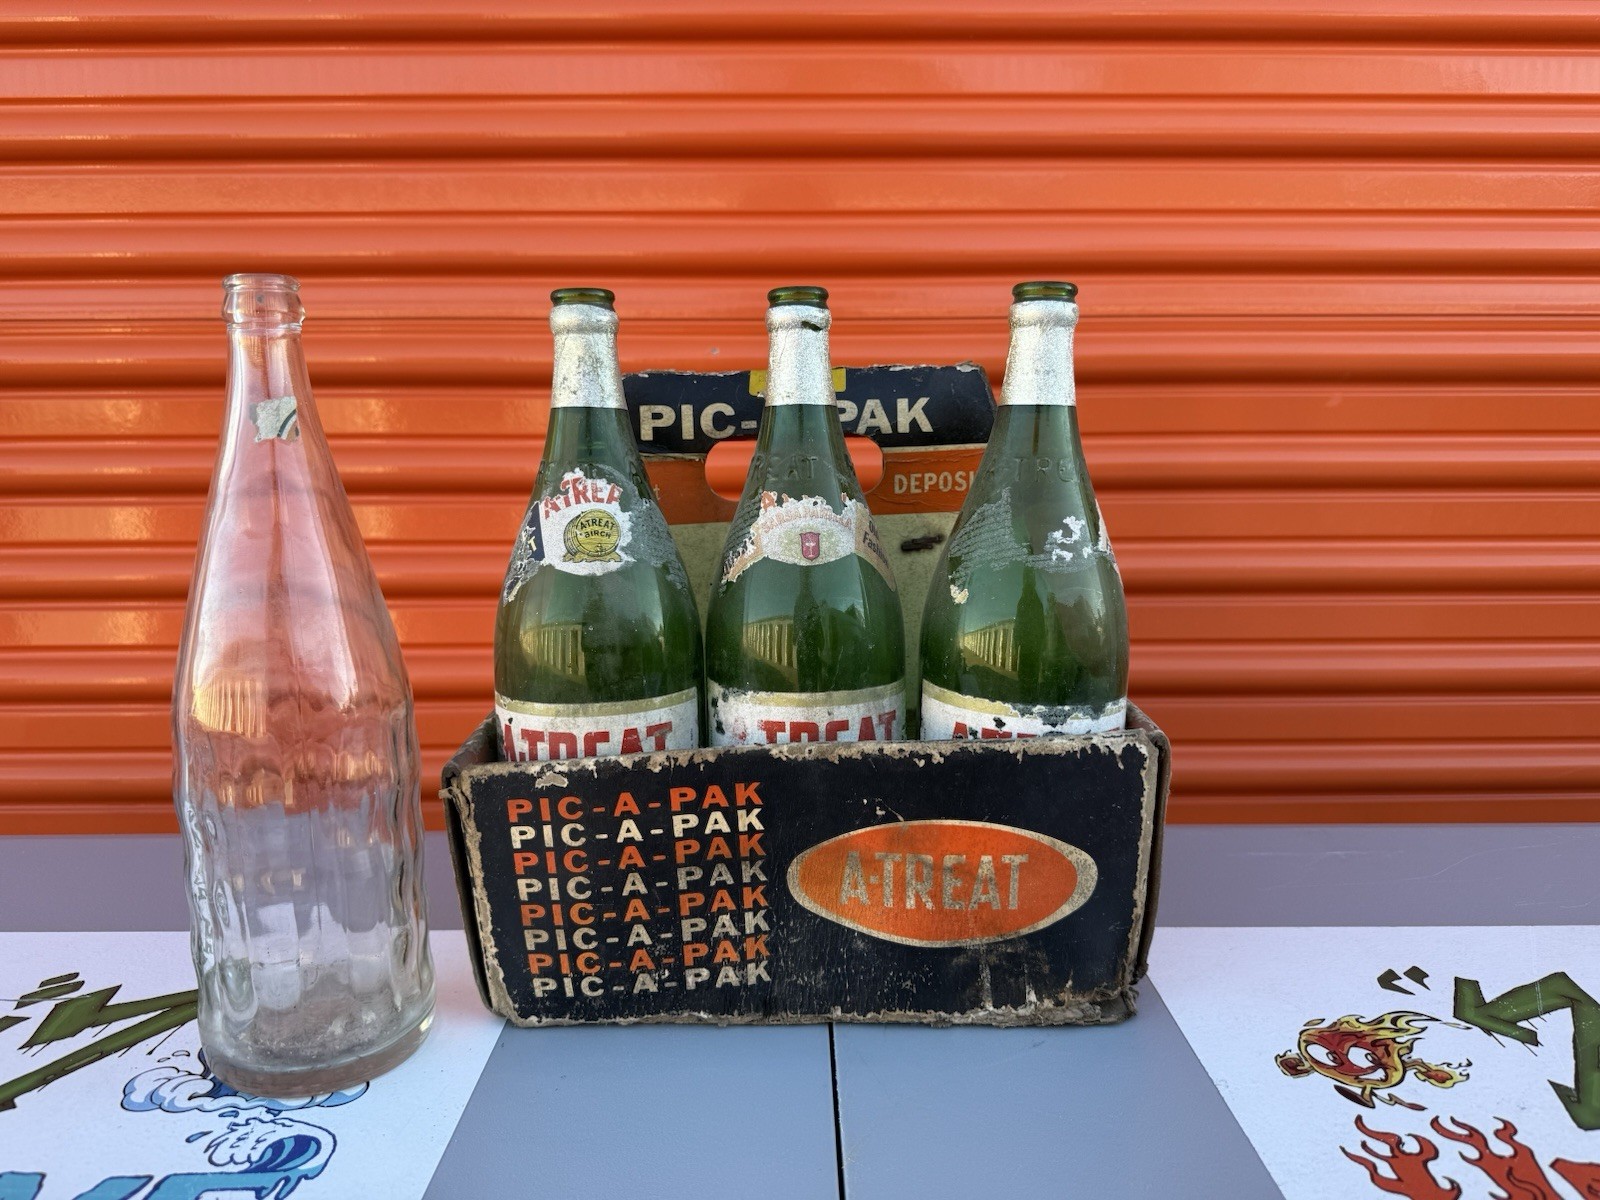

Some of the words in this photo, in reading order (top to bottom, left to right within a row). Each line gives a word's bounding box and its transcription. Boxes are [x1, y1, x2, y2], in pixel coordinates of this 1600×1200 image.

[893, 470, 976, 495] DEPOSI
[506, 782, 763, 823] PIC-A-PAK
[509, 808, 765, 849] PIC-A-PAK
[512, 833, 767, 875] PIC-A-PAK
[516, 858, 769, 901] PIC-A-PAK
[837, 850, 1029, 910] A-TREAT
[520, 884, 770, 927] PIC-A-PAK
[523, 908, 771, 951] PIC-A-PAK
[527, 934, 771, 975] PIC-A-PAK
[532, 959, 772, 998] PIC-A-PAK
